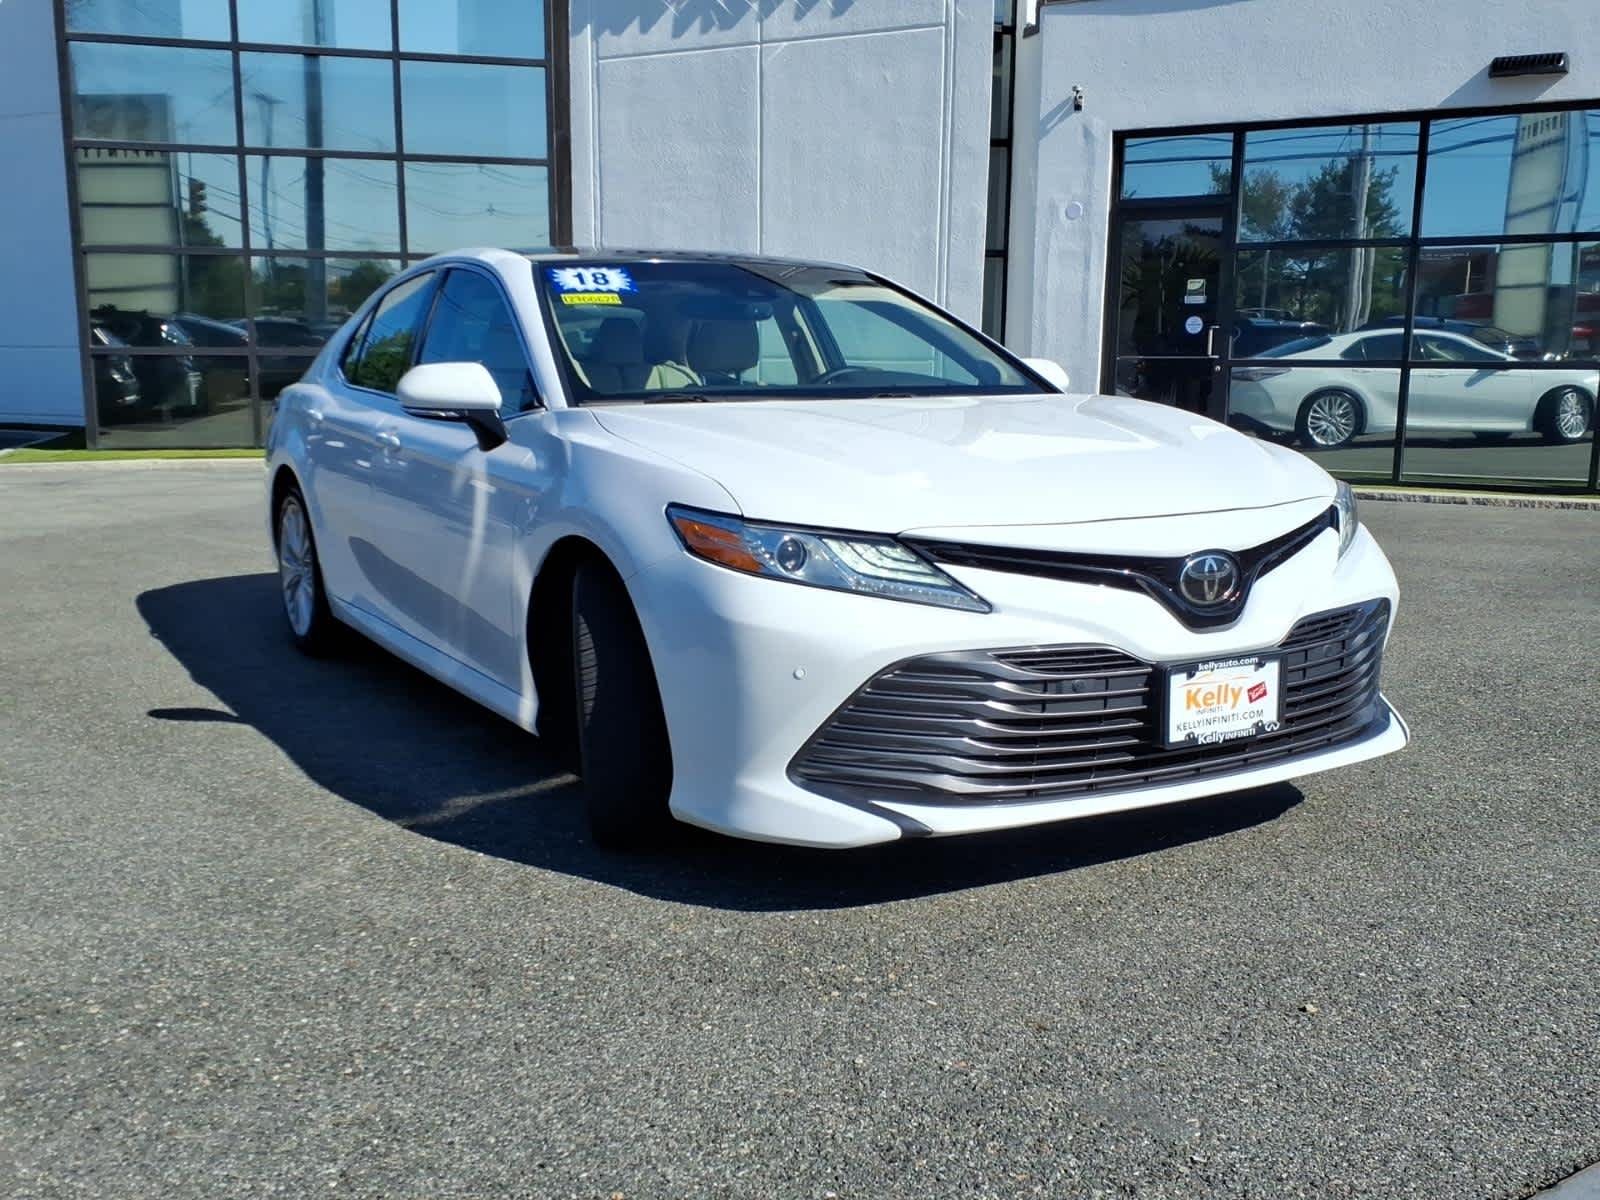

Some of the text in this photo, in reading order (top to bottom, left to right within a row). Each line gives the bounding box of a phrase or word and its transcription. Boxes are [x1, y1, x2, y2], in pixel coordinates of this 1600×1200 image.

[573, 272, 609, 285] 18
[1198, 657, 1258, 672] kellyauto.com
[1186, 684, 1242, 710] Kelly
[1176, 709, 1264, 732] KELLYINFINITI.COM
